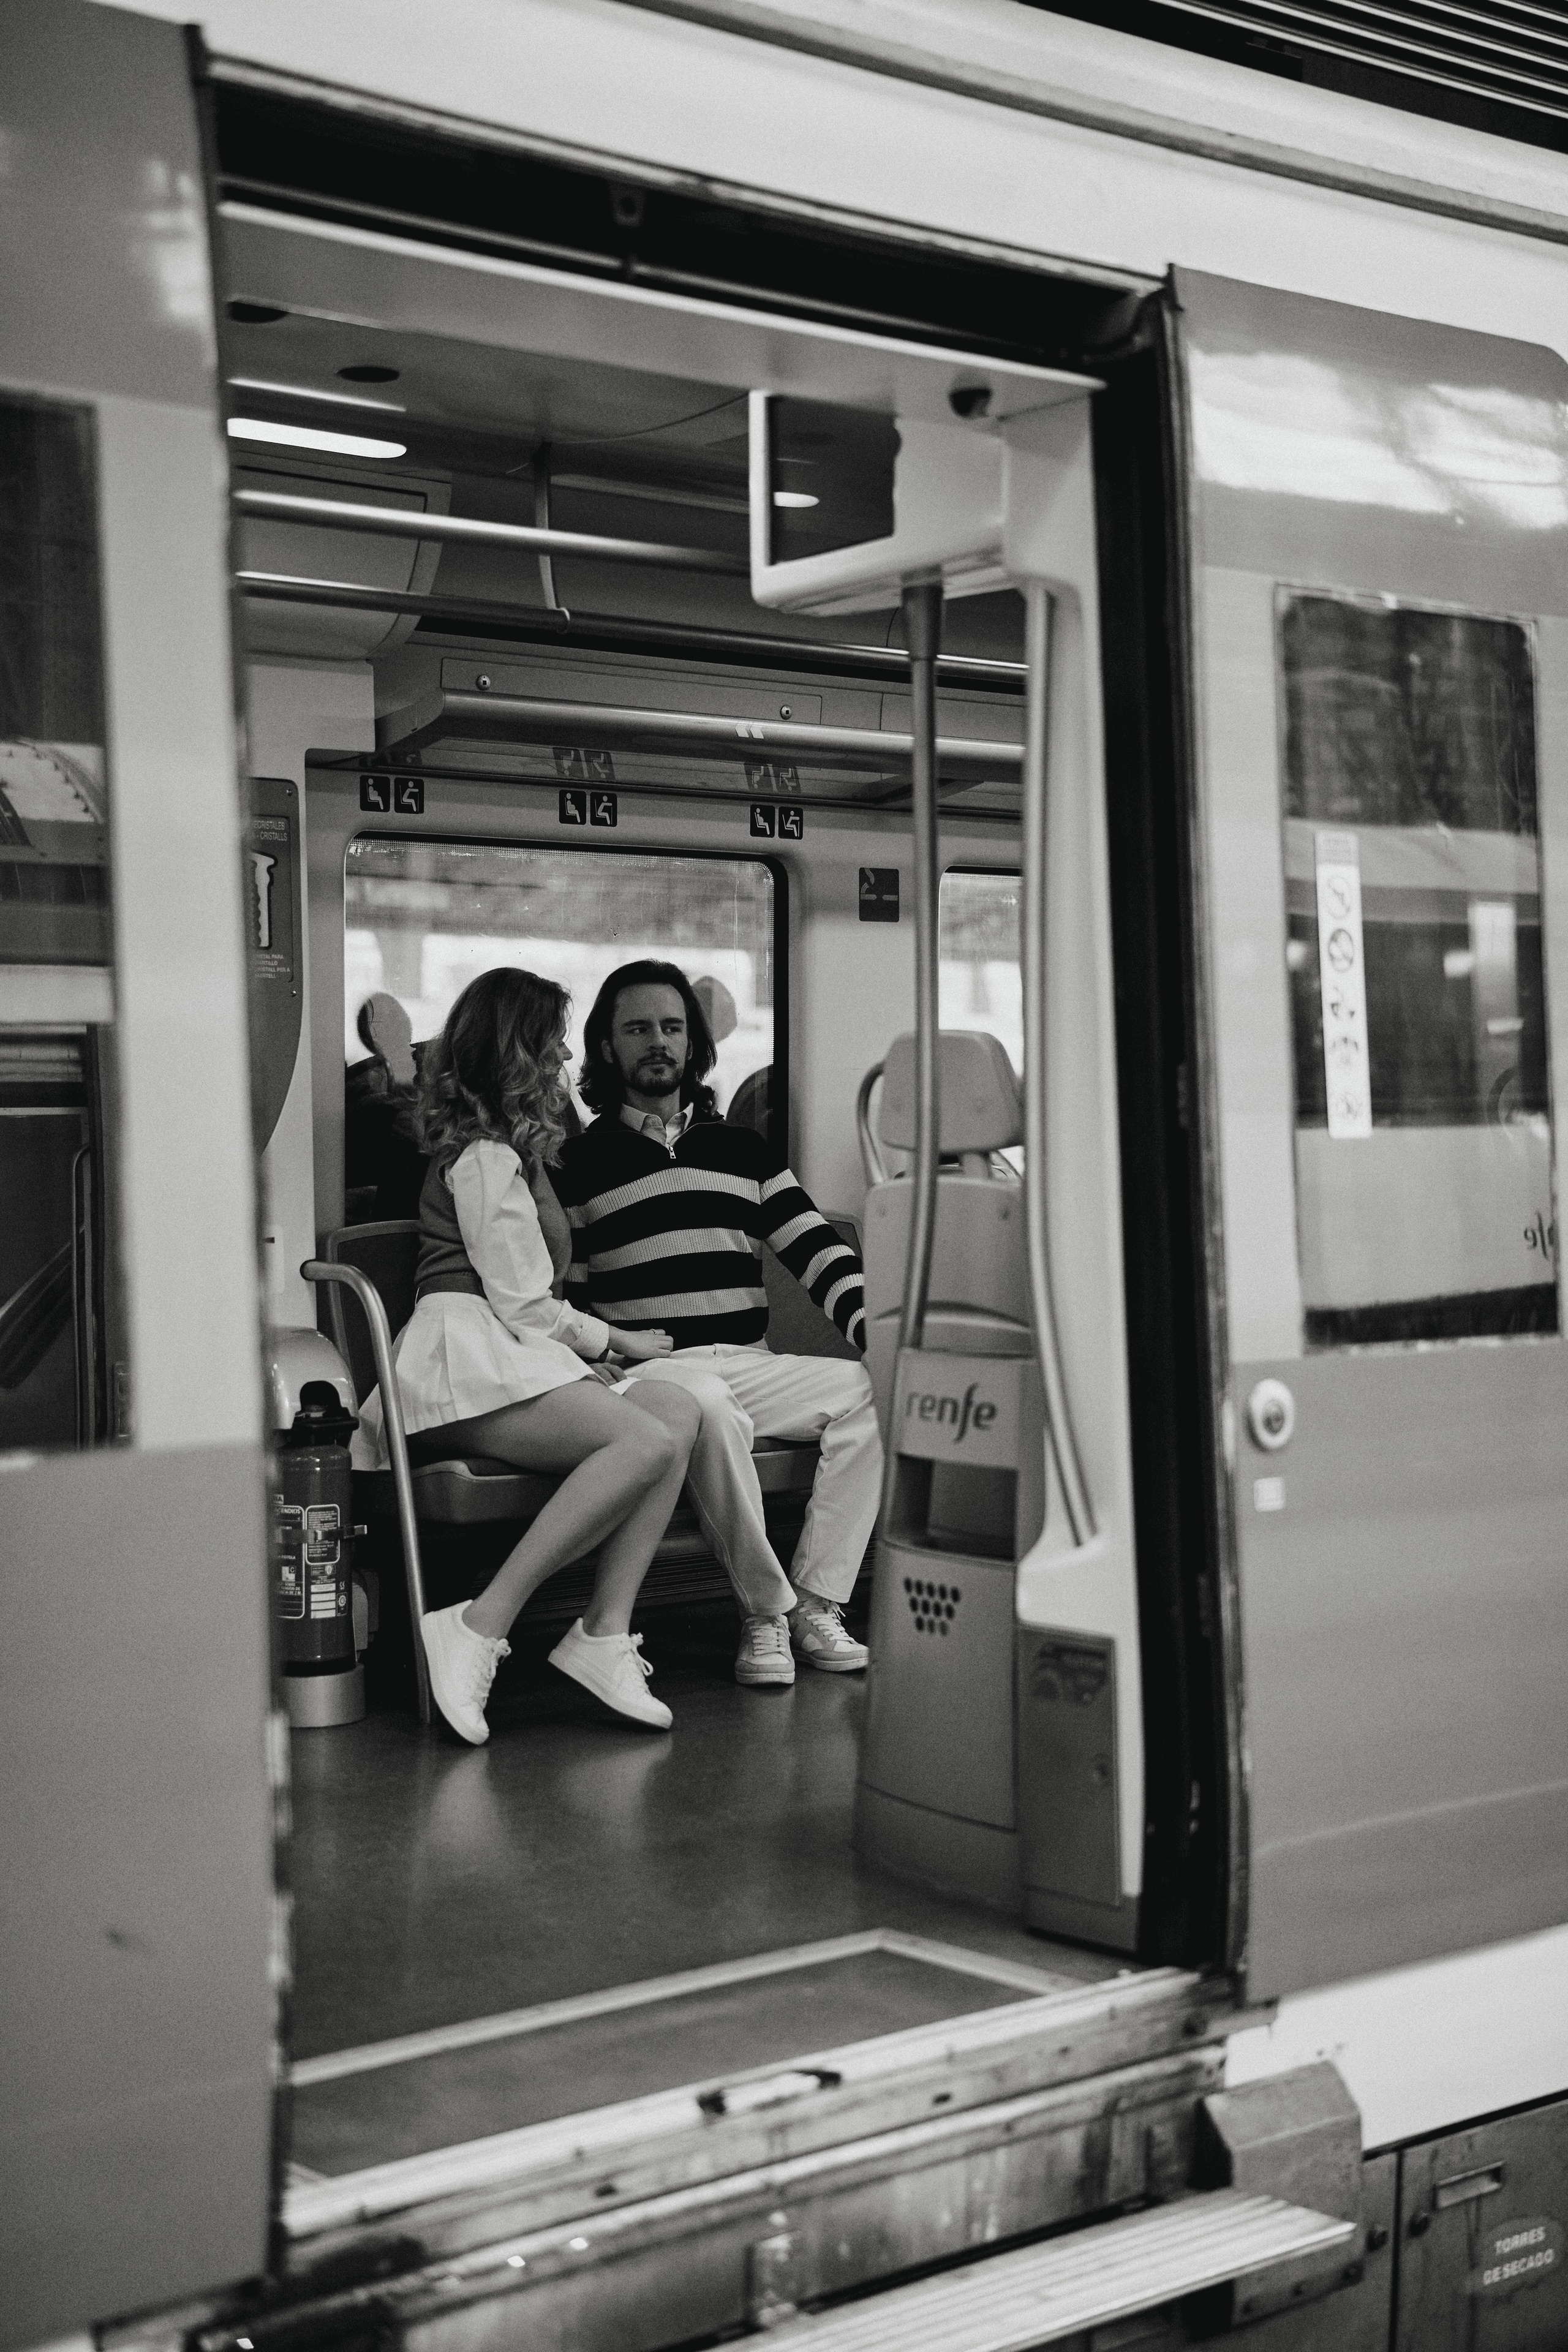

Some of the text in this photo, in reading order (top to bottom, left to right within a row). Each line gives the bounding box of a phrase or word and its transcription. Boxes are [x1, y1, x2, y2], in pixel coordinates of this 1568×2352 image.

[905, 1382, 998, 1444] renfe
[1495, 2226, 1546, 2256] TORRES
[1483, 2248, 1555, 2285] DESECADO
